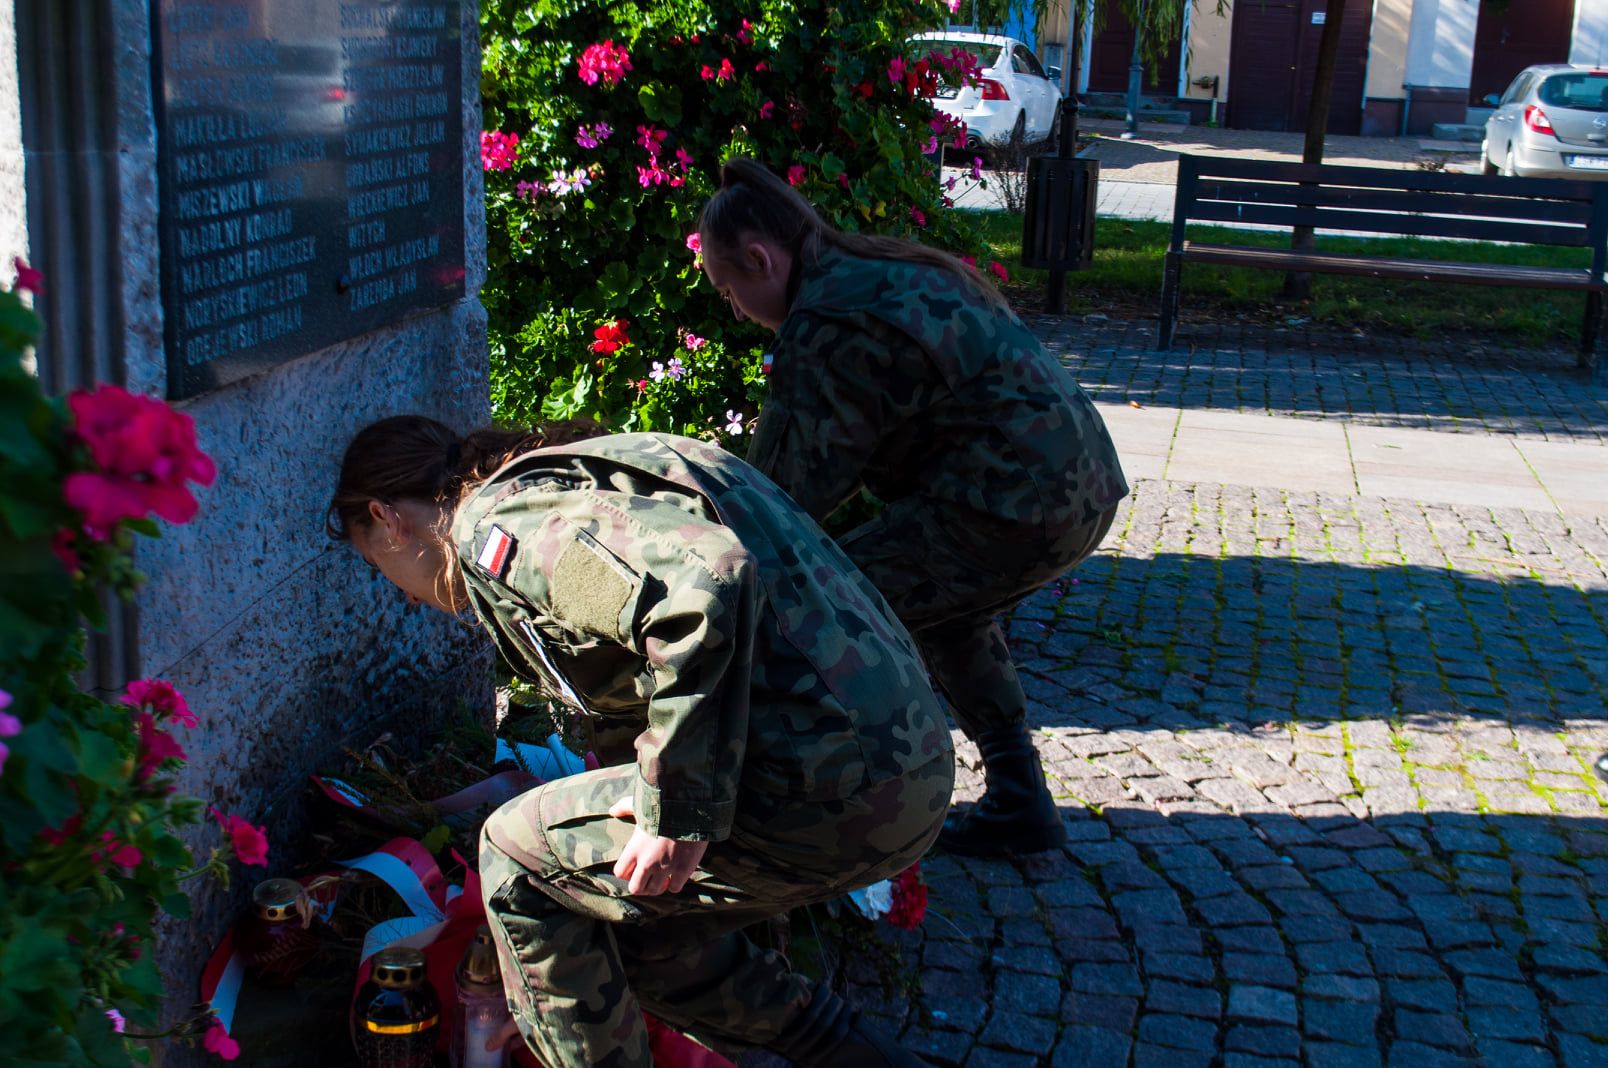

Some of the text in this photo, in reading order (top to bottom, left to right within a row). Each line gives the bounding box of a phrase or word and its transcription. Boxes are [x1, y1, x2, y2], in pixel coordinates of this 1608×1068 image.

[395, 150, 429, 179] ALFONS
[177, 181, 251, 222] MISZEWSKI
[410, 179, 430, 205] JAN
[178, 207, 293, 259] NADOLNY KONRAD
[181, 234, 317, 295] NARLOCH FRANCISZEK
[349, 268, 417, 312] ZAREMBA JAN
